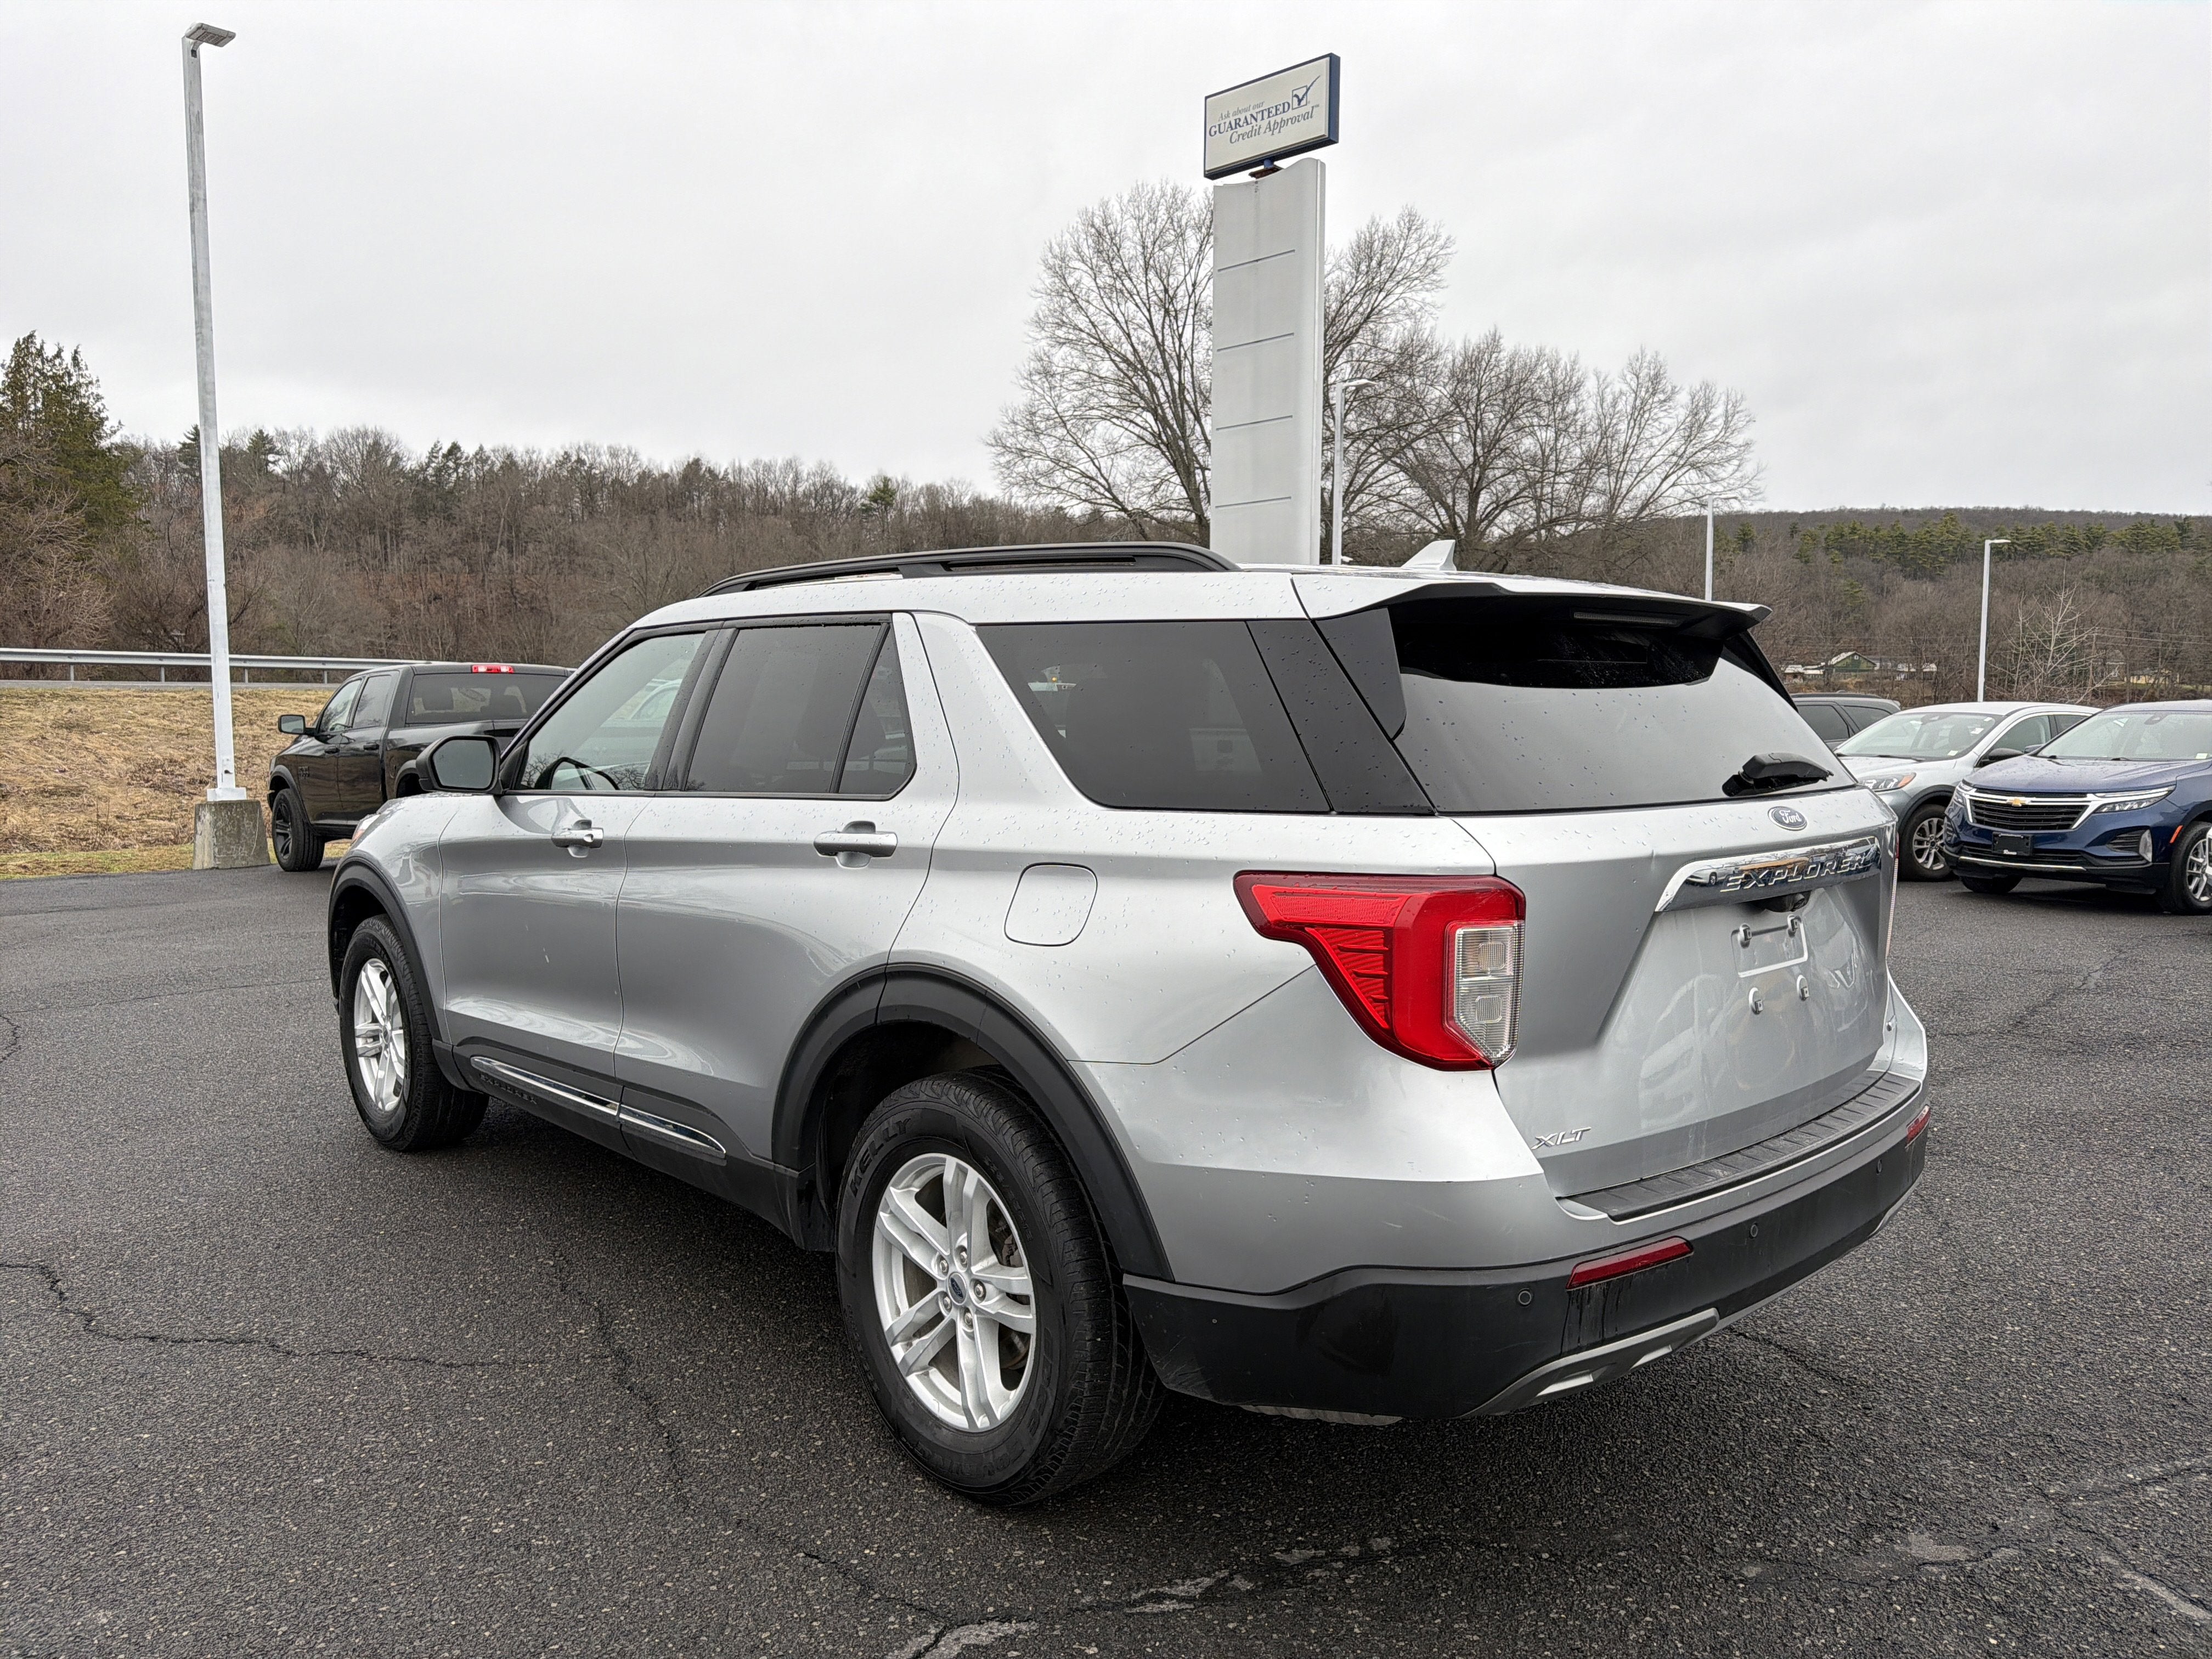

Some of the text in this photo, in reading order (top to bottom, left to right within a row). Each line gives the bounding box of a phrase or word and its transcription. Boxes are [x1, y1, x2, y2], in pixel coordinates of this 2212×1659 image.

[1209, 101, 1290, 137] GUARANTEED
[1218, 100, 1265, 121] Ask about our
[1229, 125, 1262, 144] Credit
[1779, 810, 1802, 823] Ford
[1719, 856, 1865, 893] EXPLORER
[1531, 1126, 1592, 1150] XLT
[850, 1118, 911, 1198] KELLY
